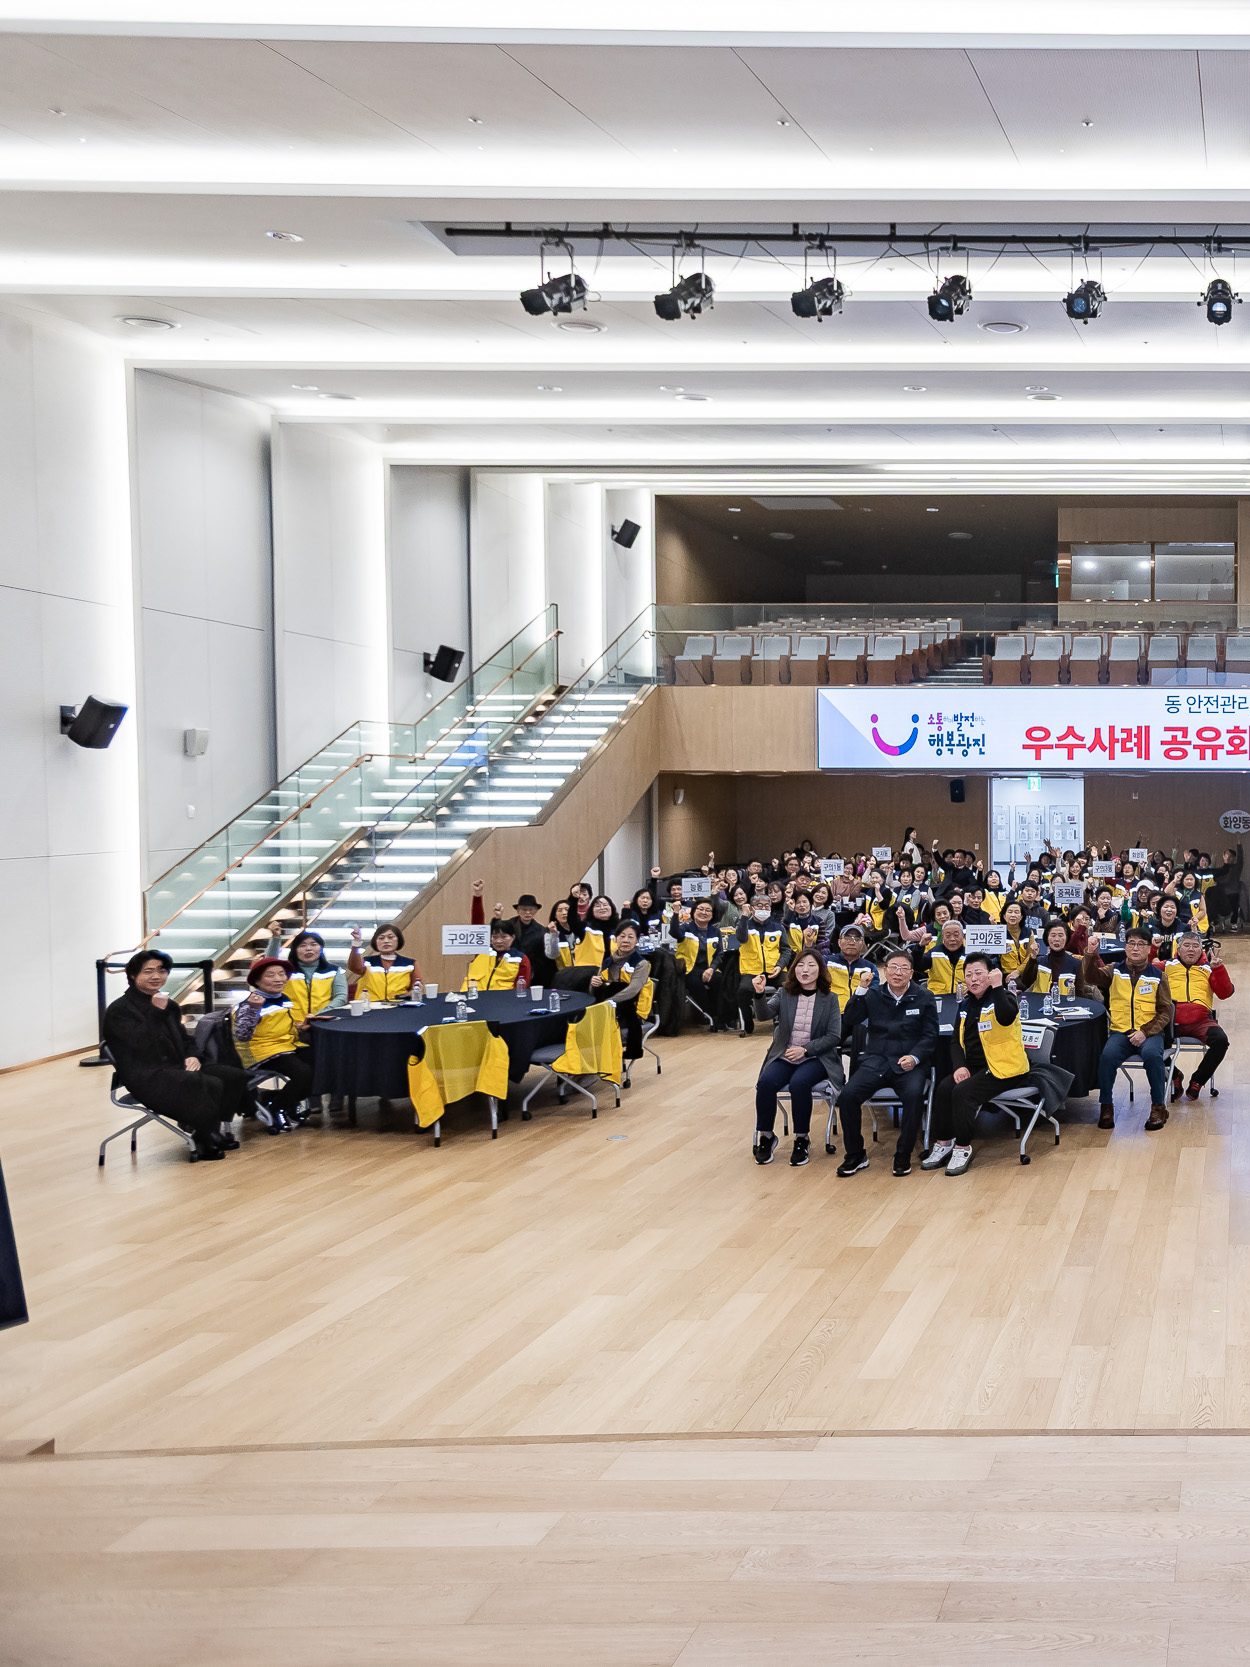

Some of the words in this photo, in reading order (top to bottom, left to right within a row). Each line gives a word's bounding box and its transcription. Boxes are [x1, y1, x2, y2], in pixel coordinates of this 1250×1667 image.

[1164, 695, 1182, 714] 동
[927, 730, 986, 757] 행복광진
[1022, 725, 1150, 761] 우수사례
[1222, 815, 1250, 829] 화양동
[1057, 888, 1081, 898] 중곡4동
[447, 932, 486, 946] 구의2동
[969, 932, 1003, 945] 구의2동
